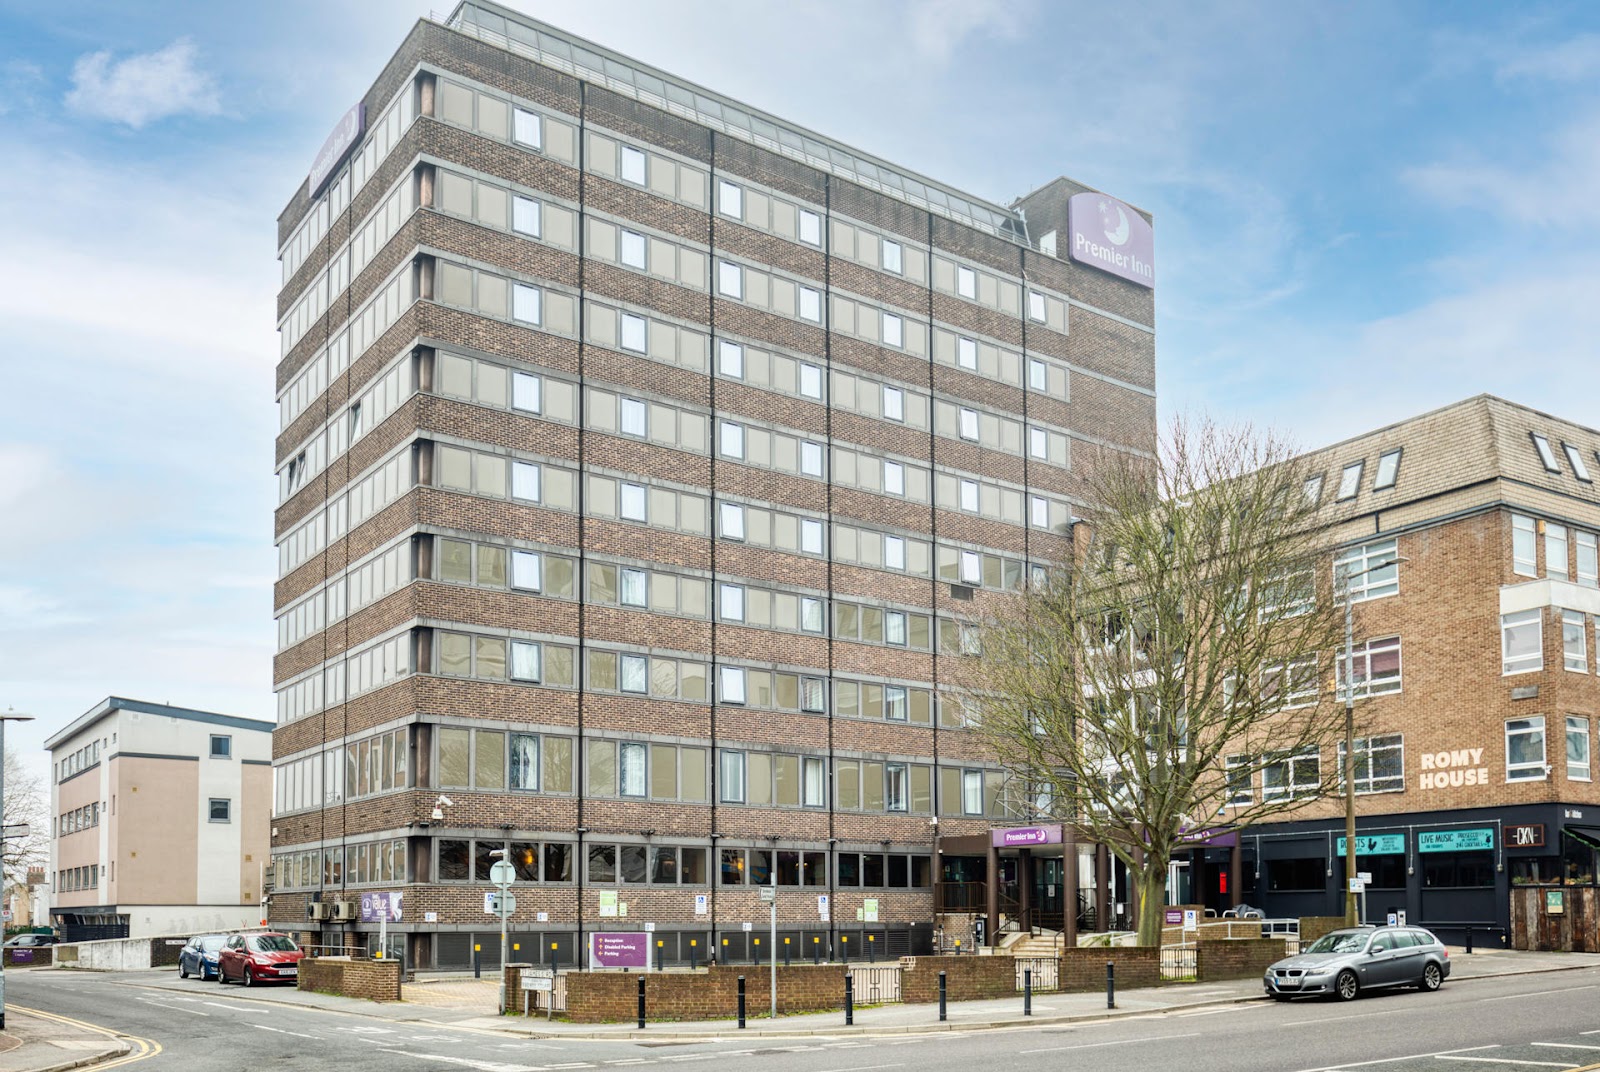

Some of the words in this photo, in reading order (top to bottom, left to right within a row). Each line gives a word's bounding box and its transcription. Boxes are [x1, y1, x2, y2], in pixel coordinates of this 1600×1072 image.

[1076, 233, 1130, 268] Premier
[1131, 254, 1152, 278] Inn
[1421, 747, 1484, 770] ROMY
[1419, 767, 1489, 790] HOUSE
[1006, 833, 1027, 841] Premier
[1027, 832, 1036, 840] Inn
[1340, 838, 1365, 849] ROTS
[1420, 834, 1434, 844] LIVE
[1435, 833, 1454, 843] MUSIC
